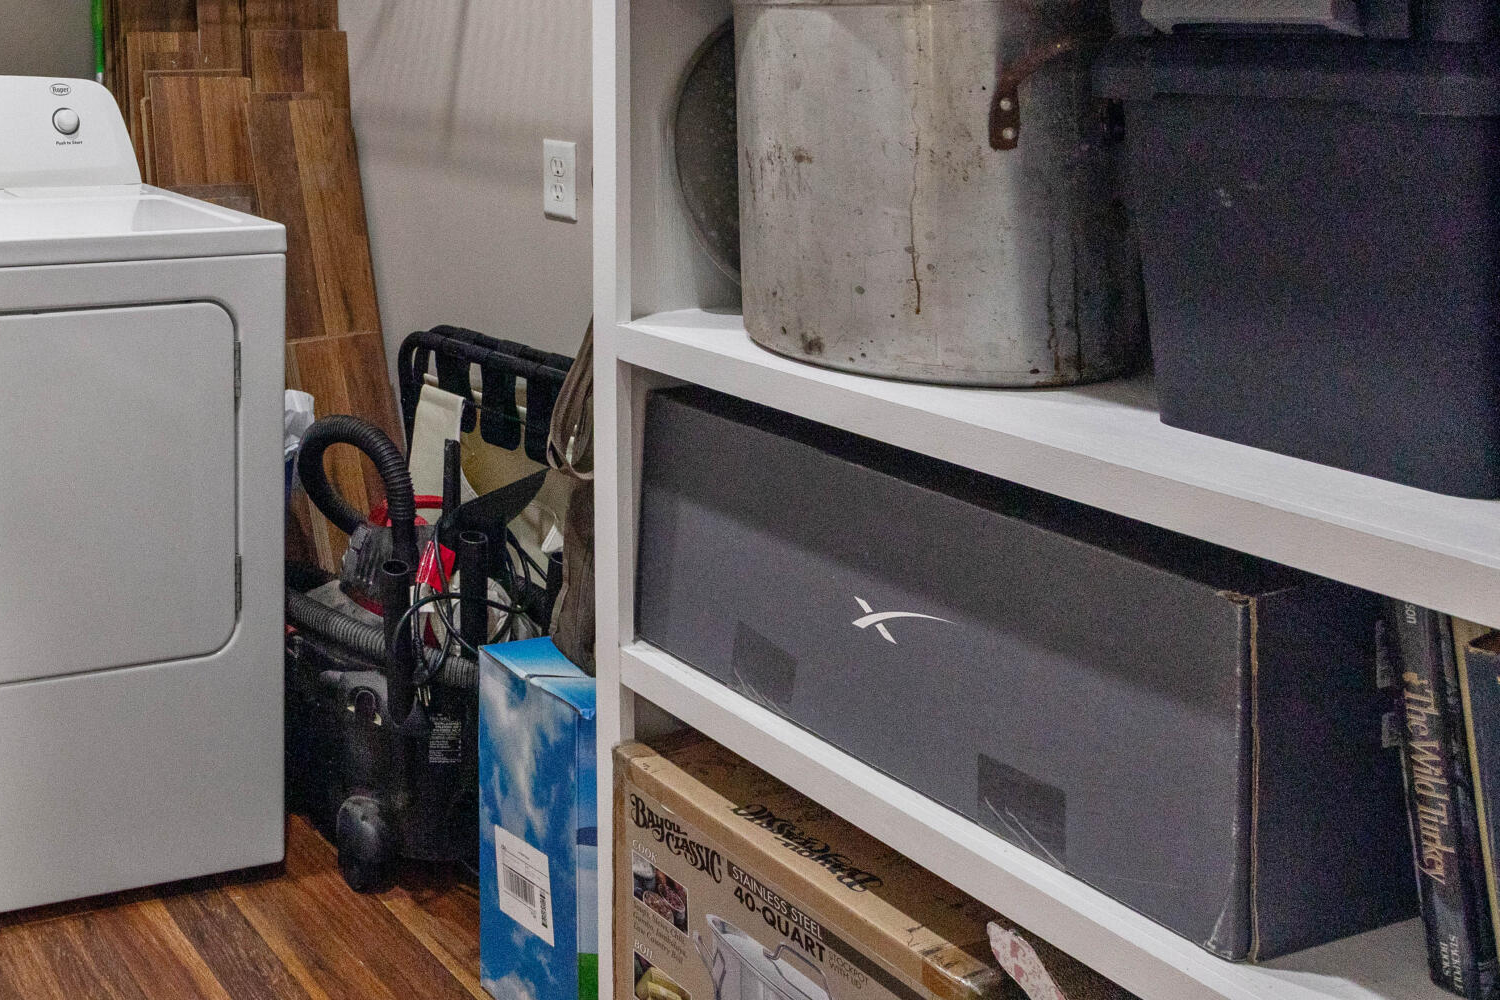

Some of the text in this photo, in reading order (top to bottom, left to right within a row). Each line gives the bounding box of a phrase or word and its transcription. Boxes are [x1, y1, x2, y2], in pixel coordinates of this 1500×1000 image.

[1403, 688, 1455, 885] The Wild Turkey
[632, 840, 658, 863] COOK
[732, 866, 823, 941] STAINLESS STEEL
[733, 885, 826, 963] 40-QUART
[634, 940, 655, 960] BOIL
[827, 950, 869, 986] STOCKPOT
[828, 960, 849, 980] WITH
